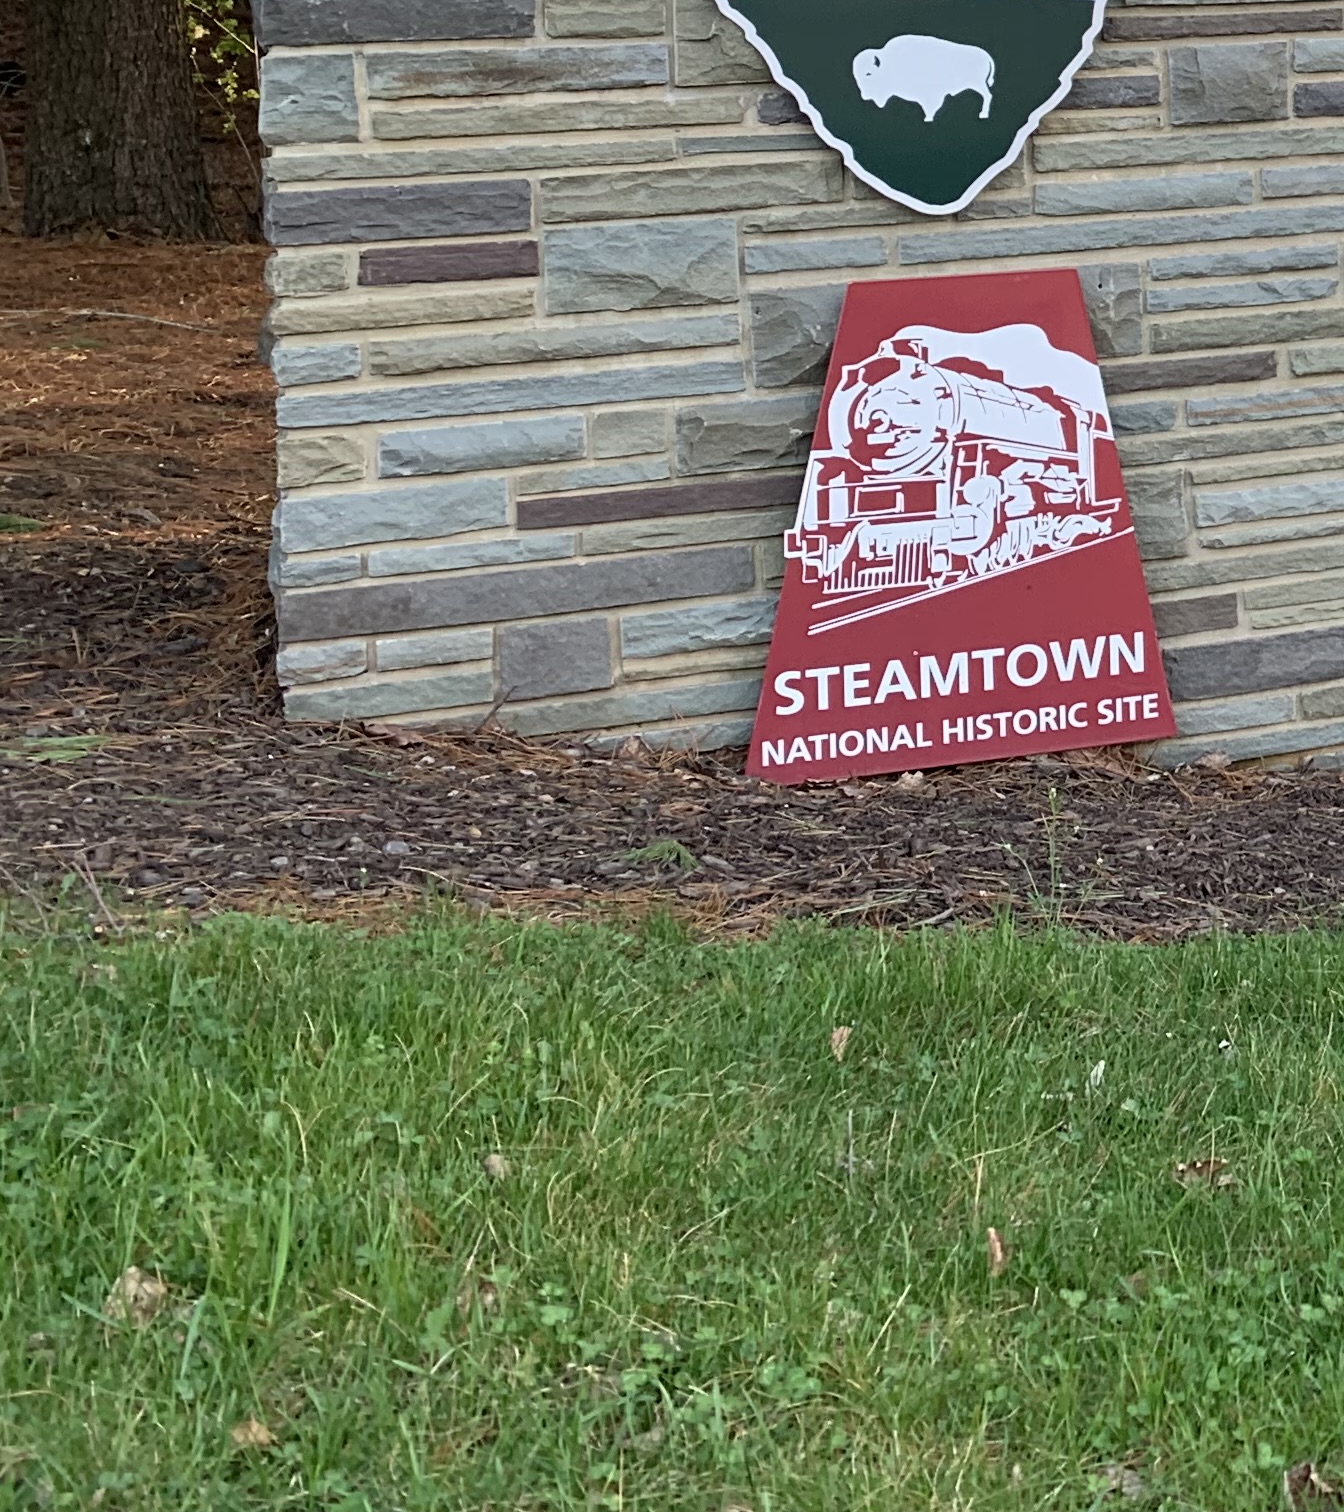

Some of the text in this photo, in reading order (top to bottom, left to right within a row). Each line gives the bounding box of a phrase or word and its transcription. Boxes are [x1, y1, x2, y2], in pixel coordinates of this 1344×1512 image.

[773, 632, 1144, 717] STEAMTOWN
[762, 693, 1158, 766] NATIONAL HISTORIC SITE
